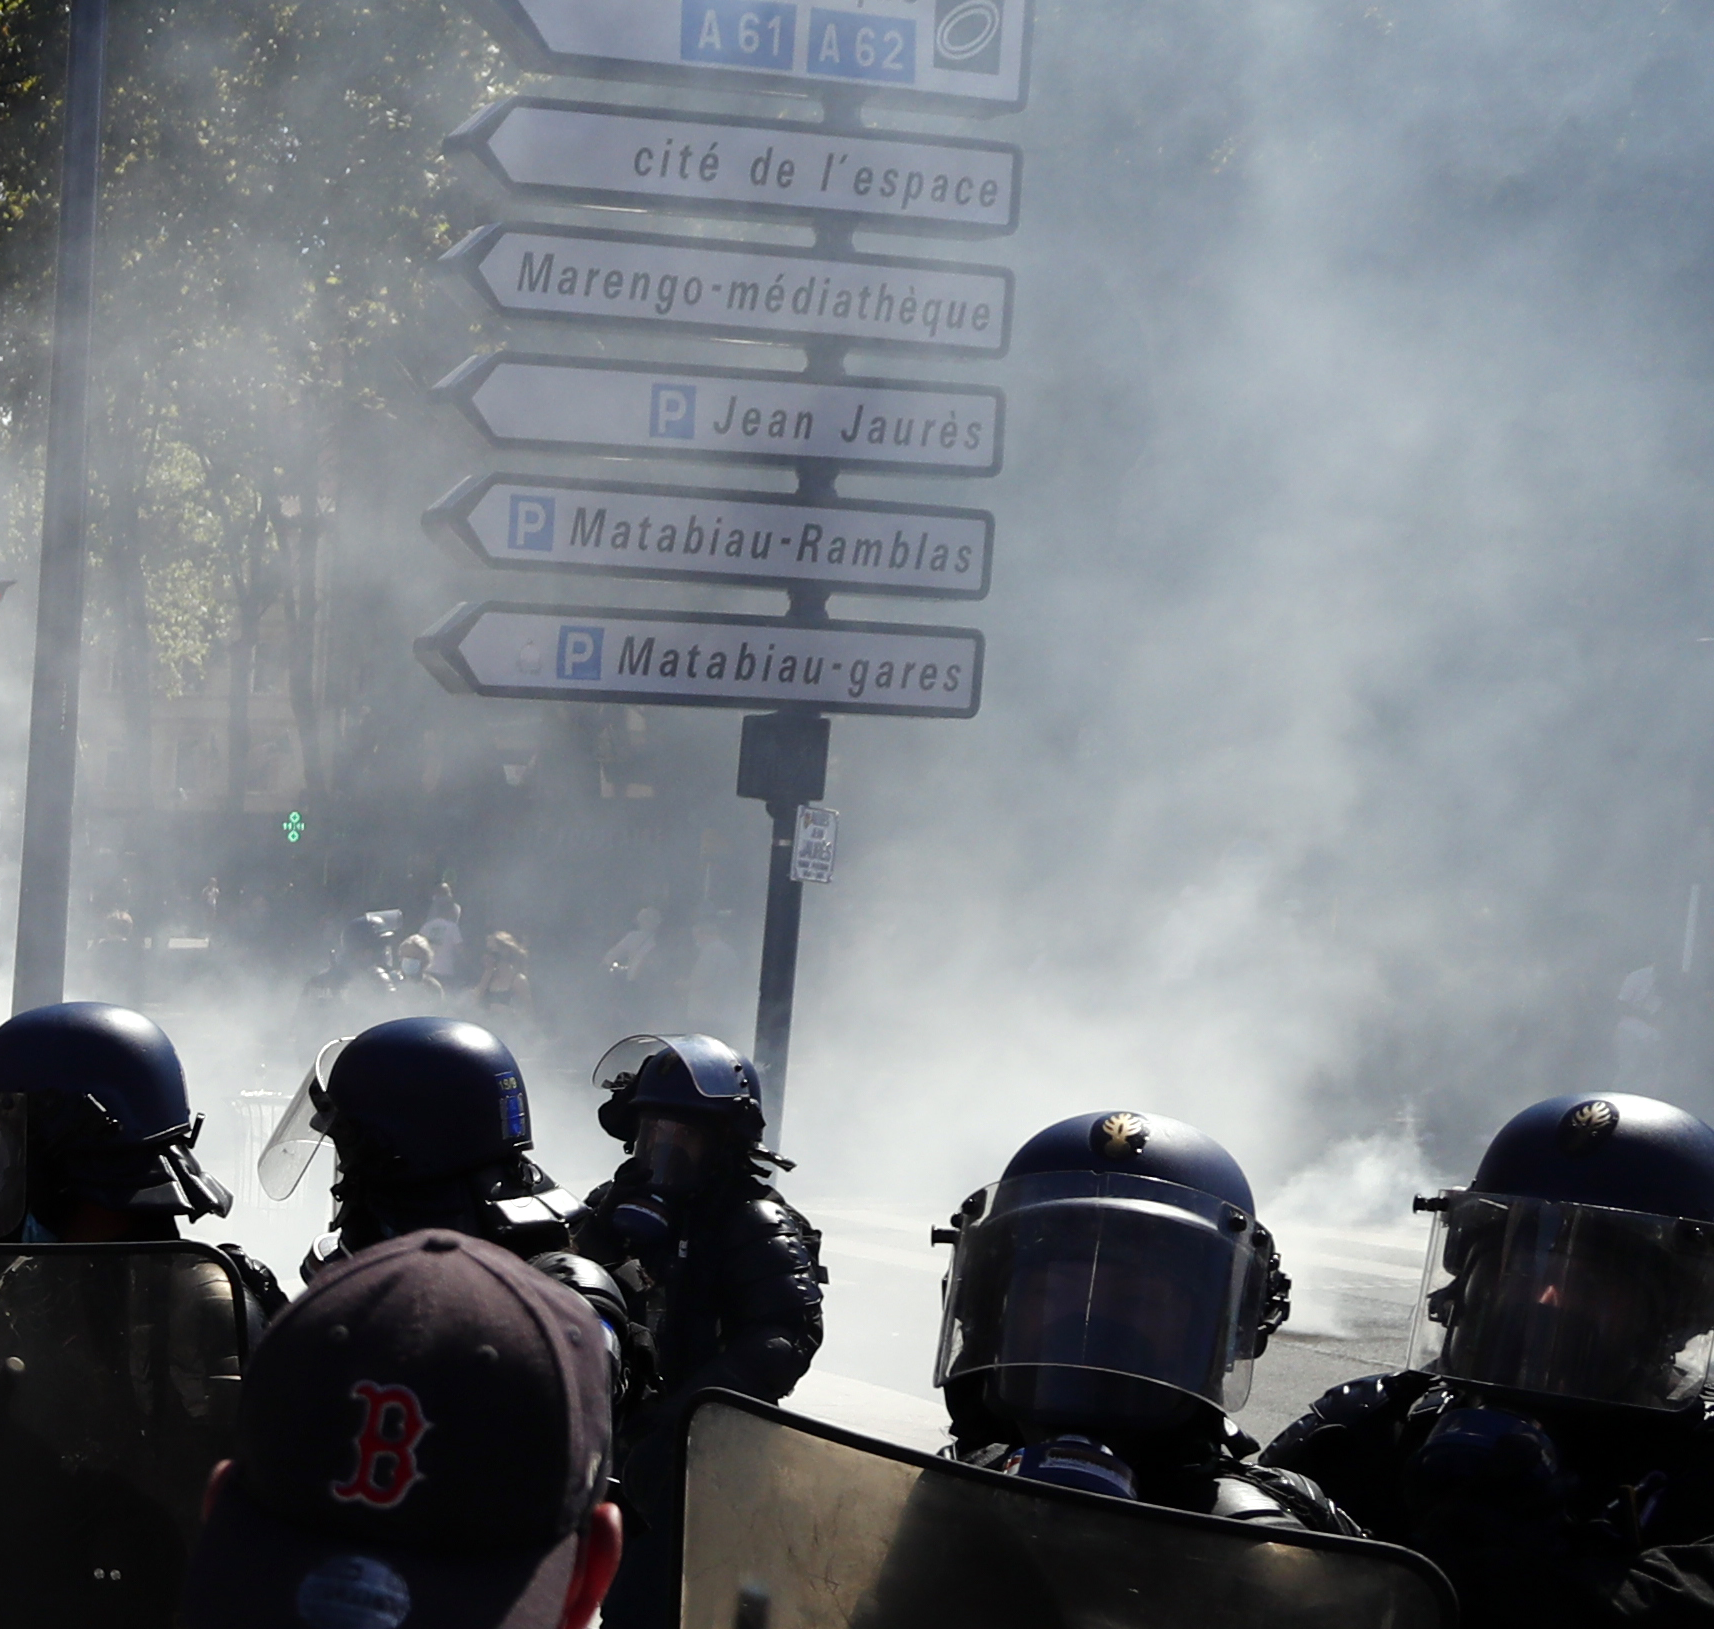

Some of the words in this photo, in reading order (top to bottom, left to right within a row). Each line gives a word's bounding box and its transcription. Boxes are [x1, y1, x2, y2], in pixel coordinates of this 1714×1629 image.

[698, 9, 722, 51] A
[738, 12, 783, 57] 61
[818, 22, 840, 64] A
[855, 26, 905, 71] 62
[632, 139, 721, 184] cité
[749, 146, 796, 189] de
[819, 152, 1000, 210] l'espace
[516, 250, 992, 337] Marengo-médiathèque
[656, 388, 689, 430] P
[713, 395, 814, 442] Jean
[839, 403, 982, 451] Jaurès
[516, 499, 548, 545] P
[569, 506, 972, 574] Matabiau-Ramblas
[564, 631, 596, 676] P
[618, 635, 963, 699] Matabiau-gares
[333, 1377, 432, 1510] B
